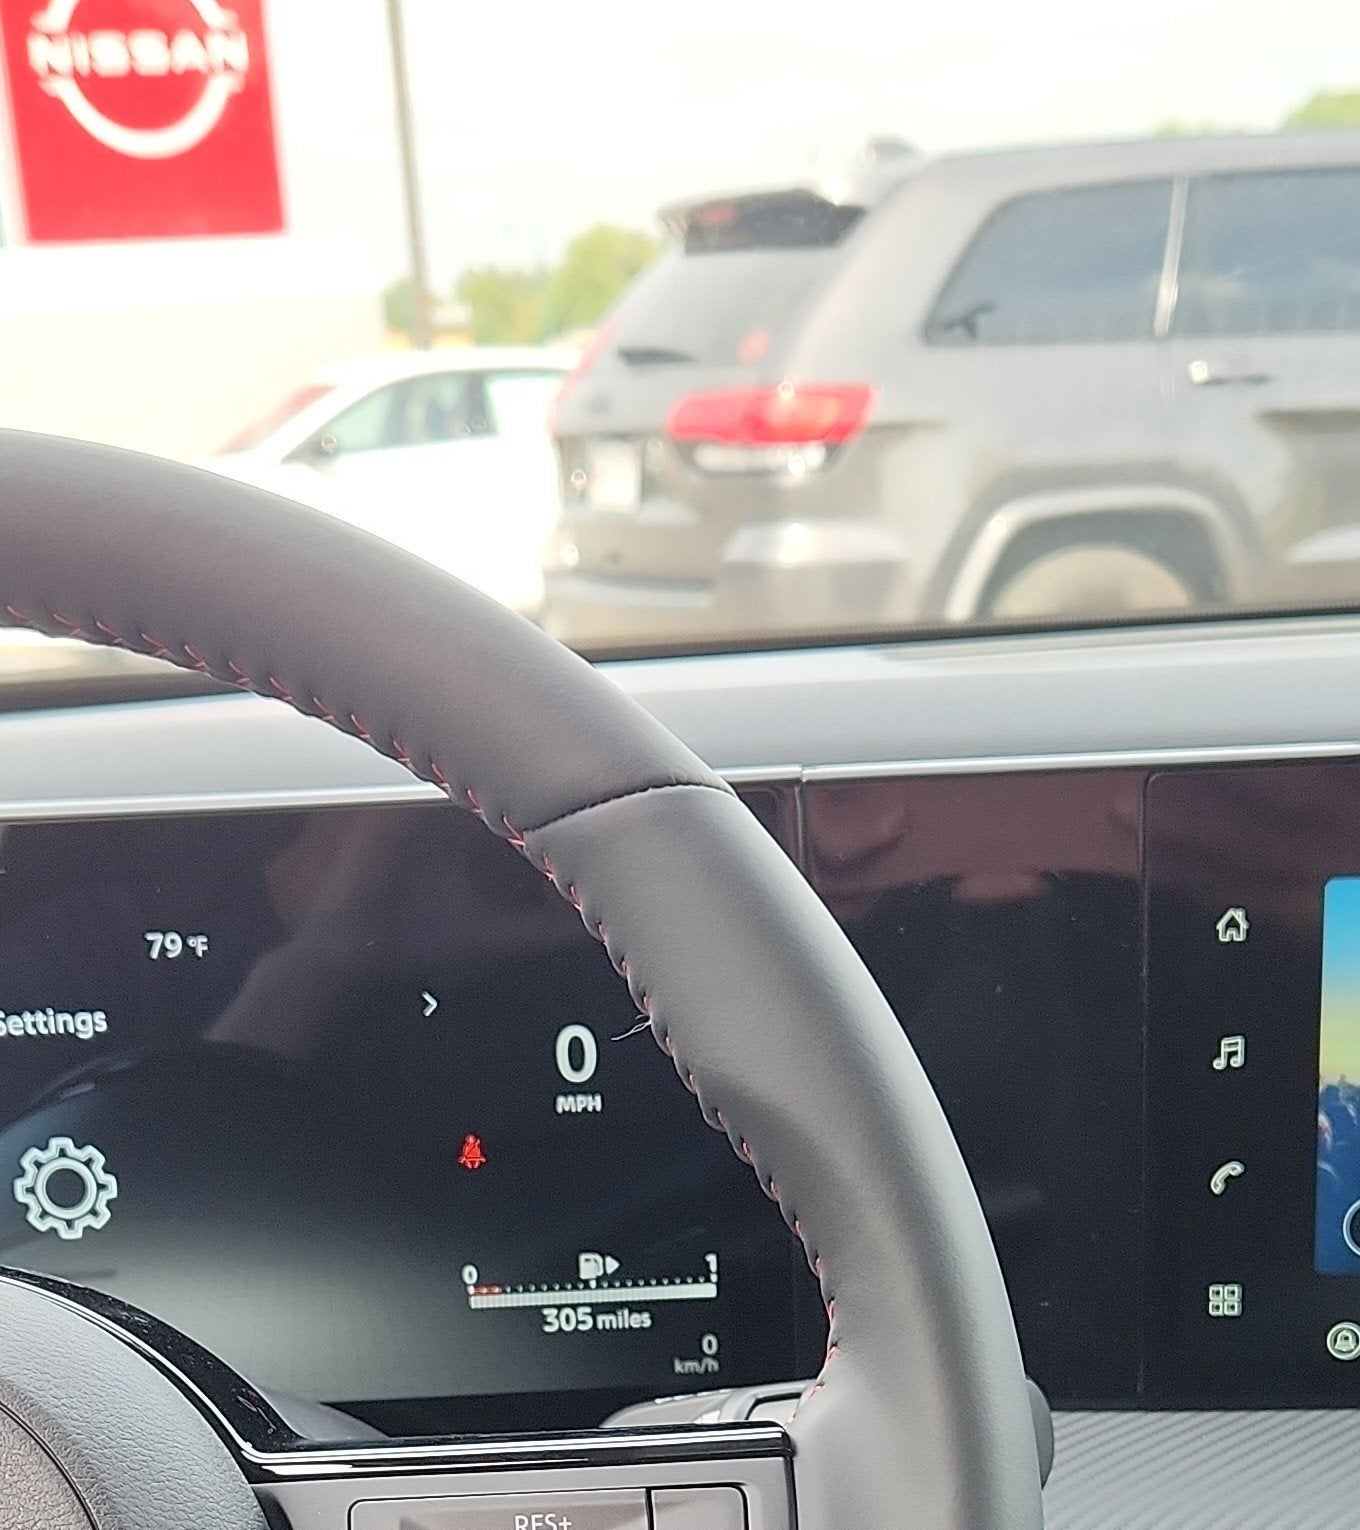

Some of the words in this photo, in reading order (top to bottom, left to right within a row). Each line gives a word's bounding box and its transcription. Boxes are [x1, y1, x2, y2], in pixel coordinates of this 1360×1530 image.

[144, 932, 183, 959] 79
[555, 1024, 597, 1083] 0
[555, 1094, 602, 1113] MPH
[461, 1264, 479, 1285] 0
[542, 1309, 593, 1332] 305
[596, 1307, 652, 1331] miles
[701, 1335, 719, 1356] 0
[674, 1356, 719, 1374] km/h
